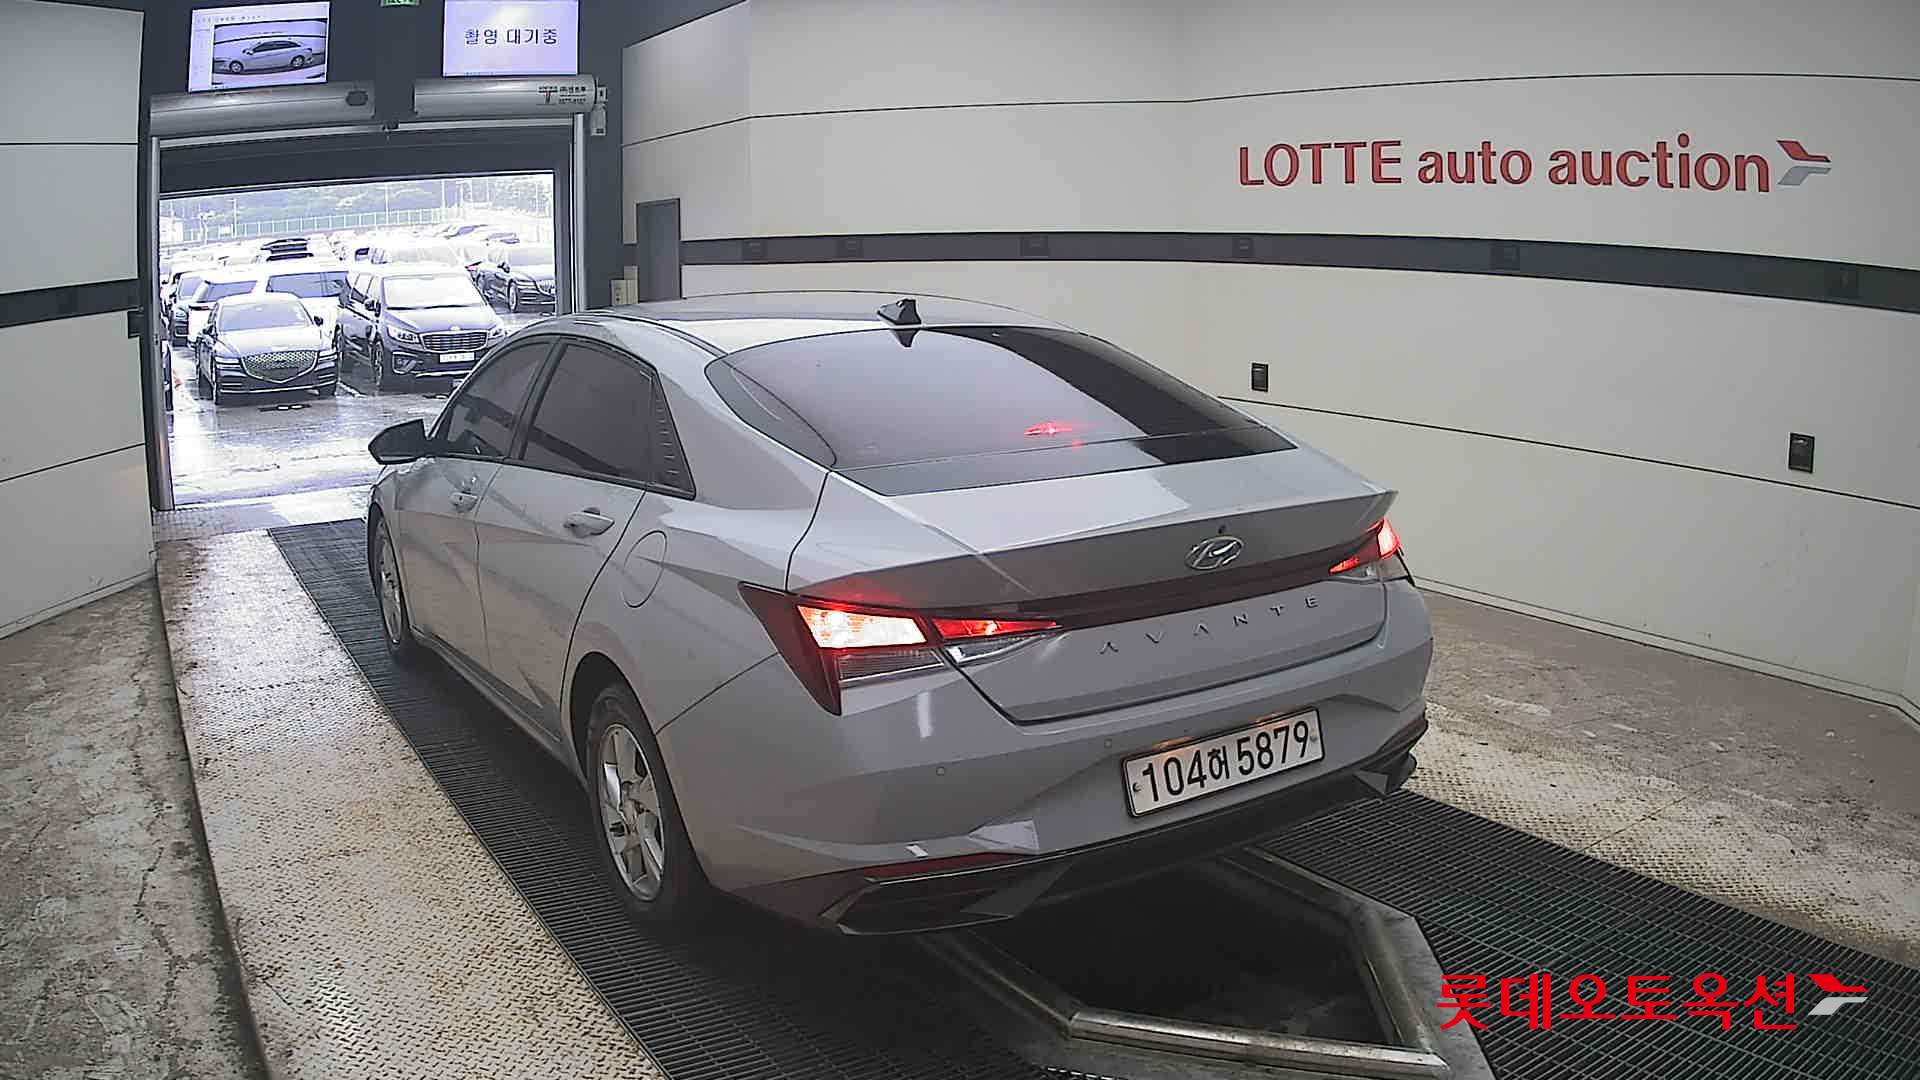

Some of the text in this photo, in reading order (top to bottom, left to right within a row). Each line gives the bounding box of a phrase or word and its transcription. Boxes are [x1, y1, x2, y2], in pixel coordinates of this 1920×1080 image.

[465, 28, 557, 45] 촬영 대기중
[1239, 133, 1770, 192] LOTTE auto auction
[1100, 596, 1319, 655] AVANTE
